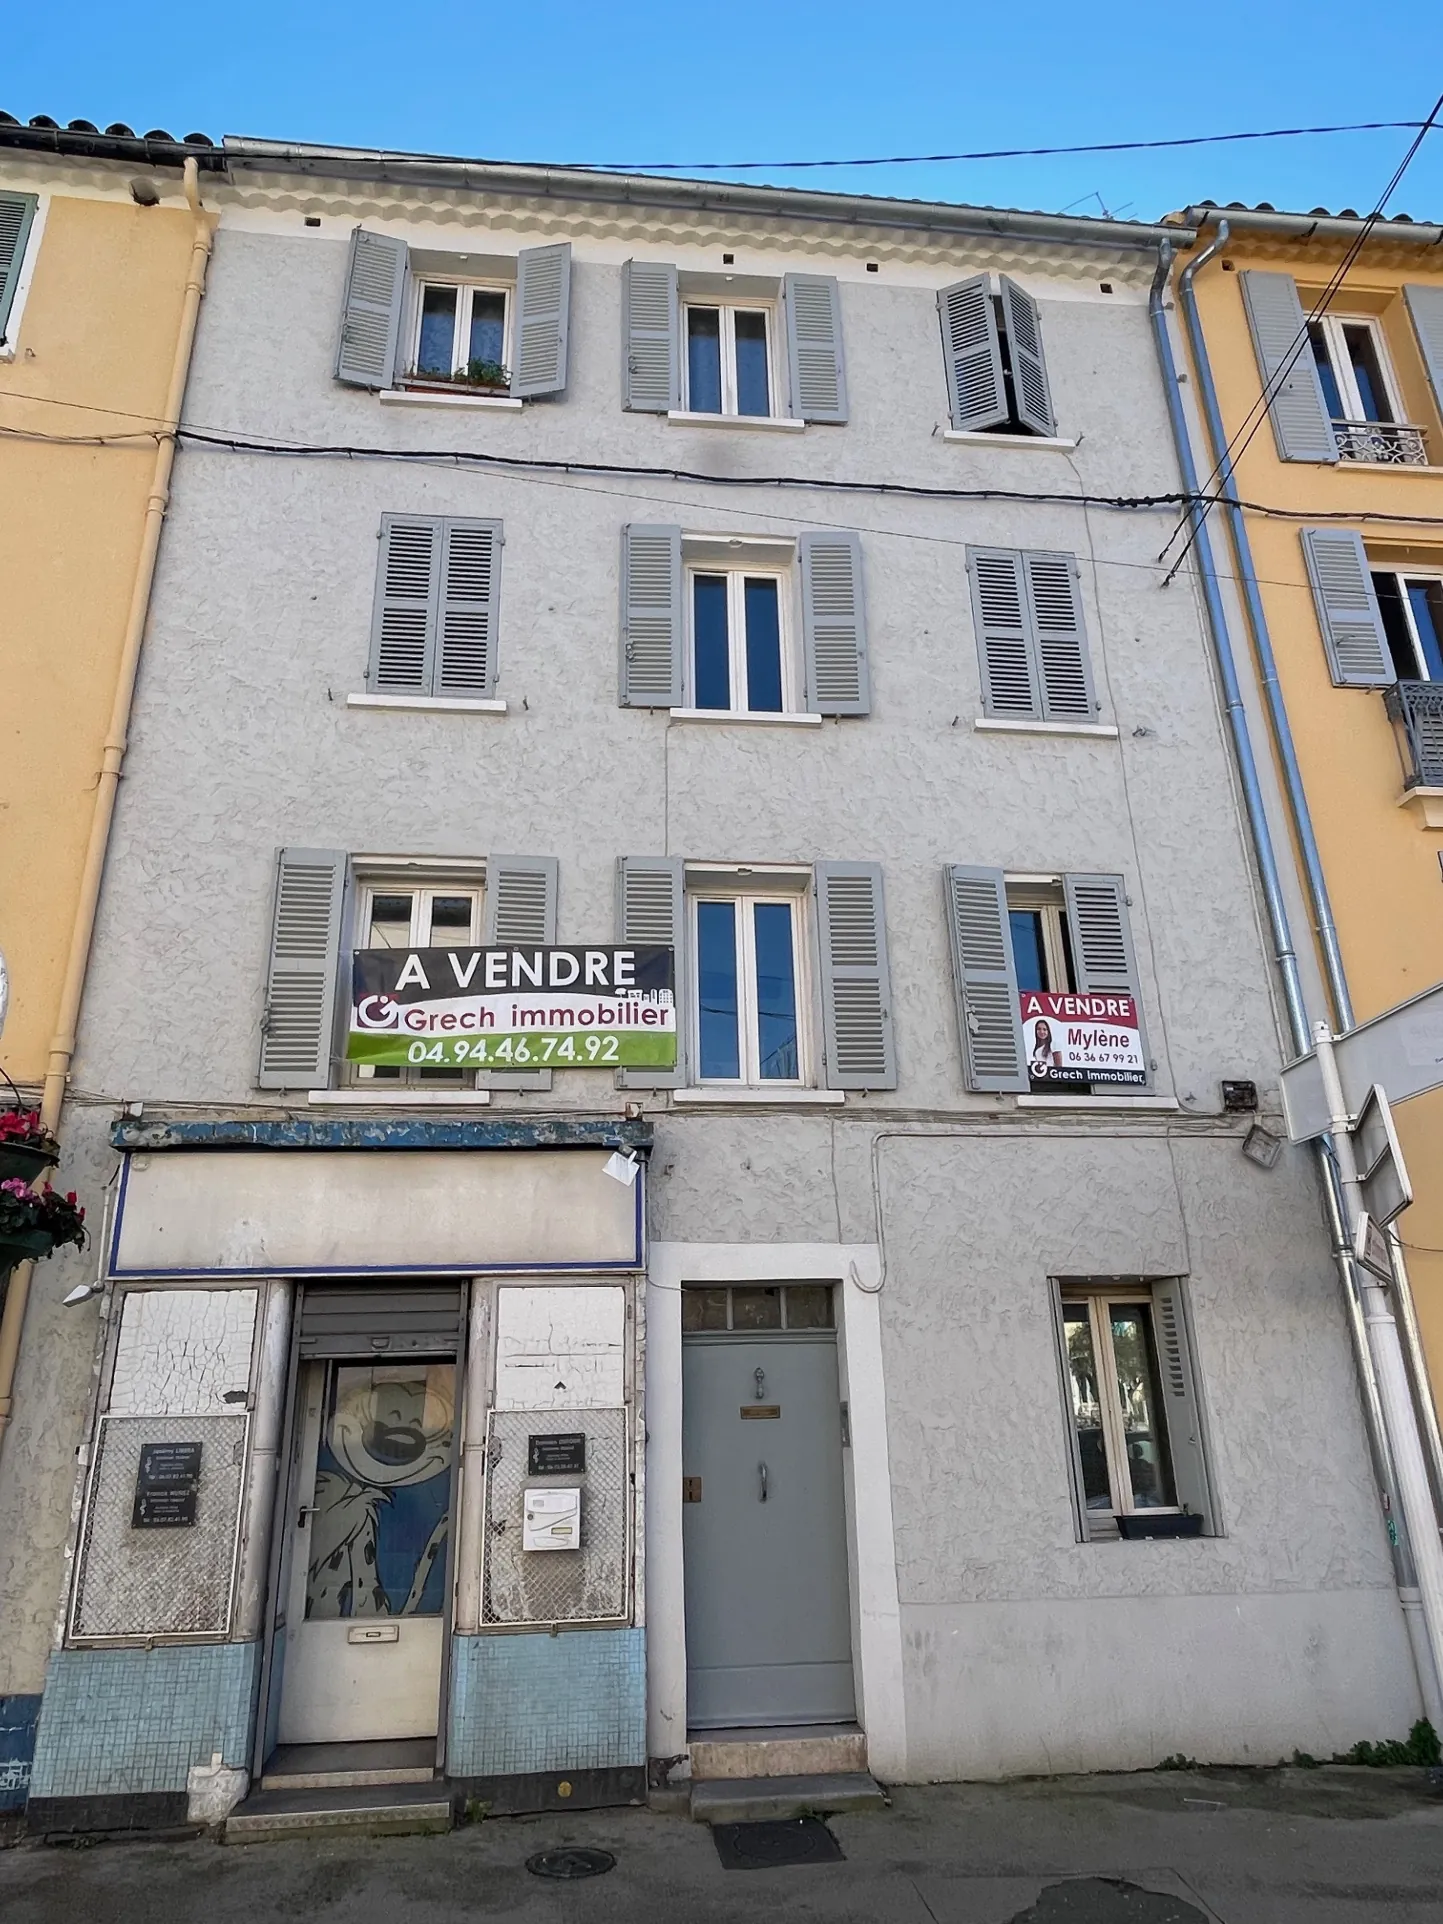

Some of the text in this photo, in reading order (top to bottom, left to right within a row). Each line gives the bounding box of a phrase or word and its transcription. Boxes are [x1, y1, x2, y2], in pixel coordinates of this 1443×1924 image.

[395, 951, 636, 991] A VENDRE
[404, 1002, 669, 1031] Grech immobilier
[1027, 996, 1131, 1017] A VENDRE
[407, 1036, 619, 1064] 04.94.46.74.92
[1068, 1028, 1130, 1050] Mylène
[1069, 1051, 1138, 1064] 06 36 67 99 21
[1049, 1068, 1083, 1080] Grech
